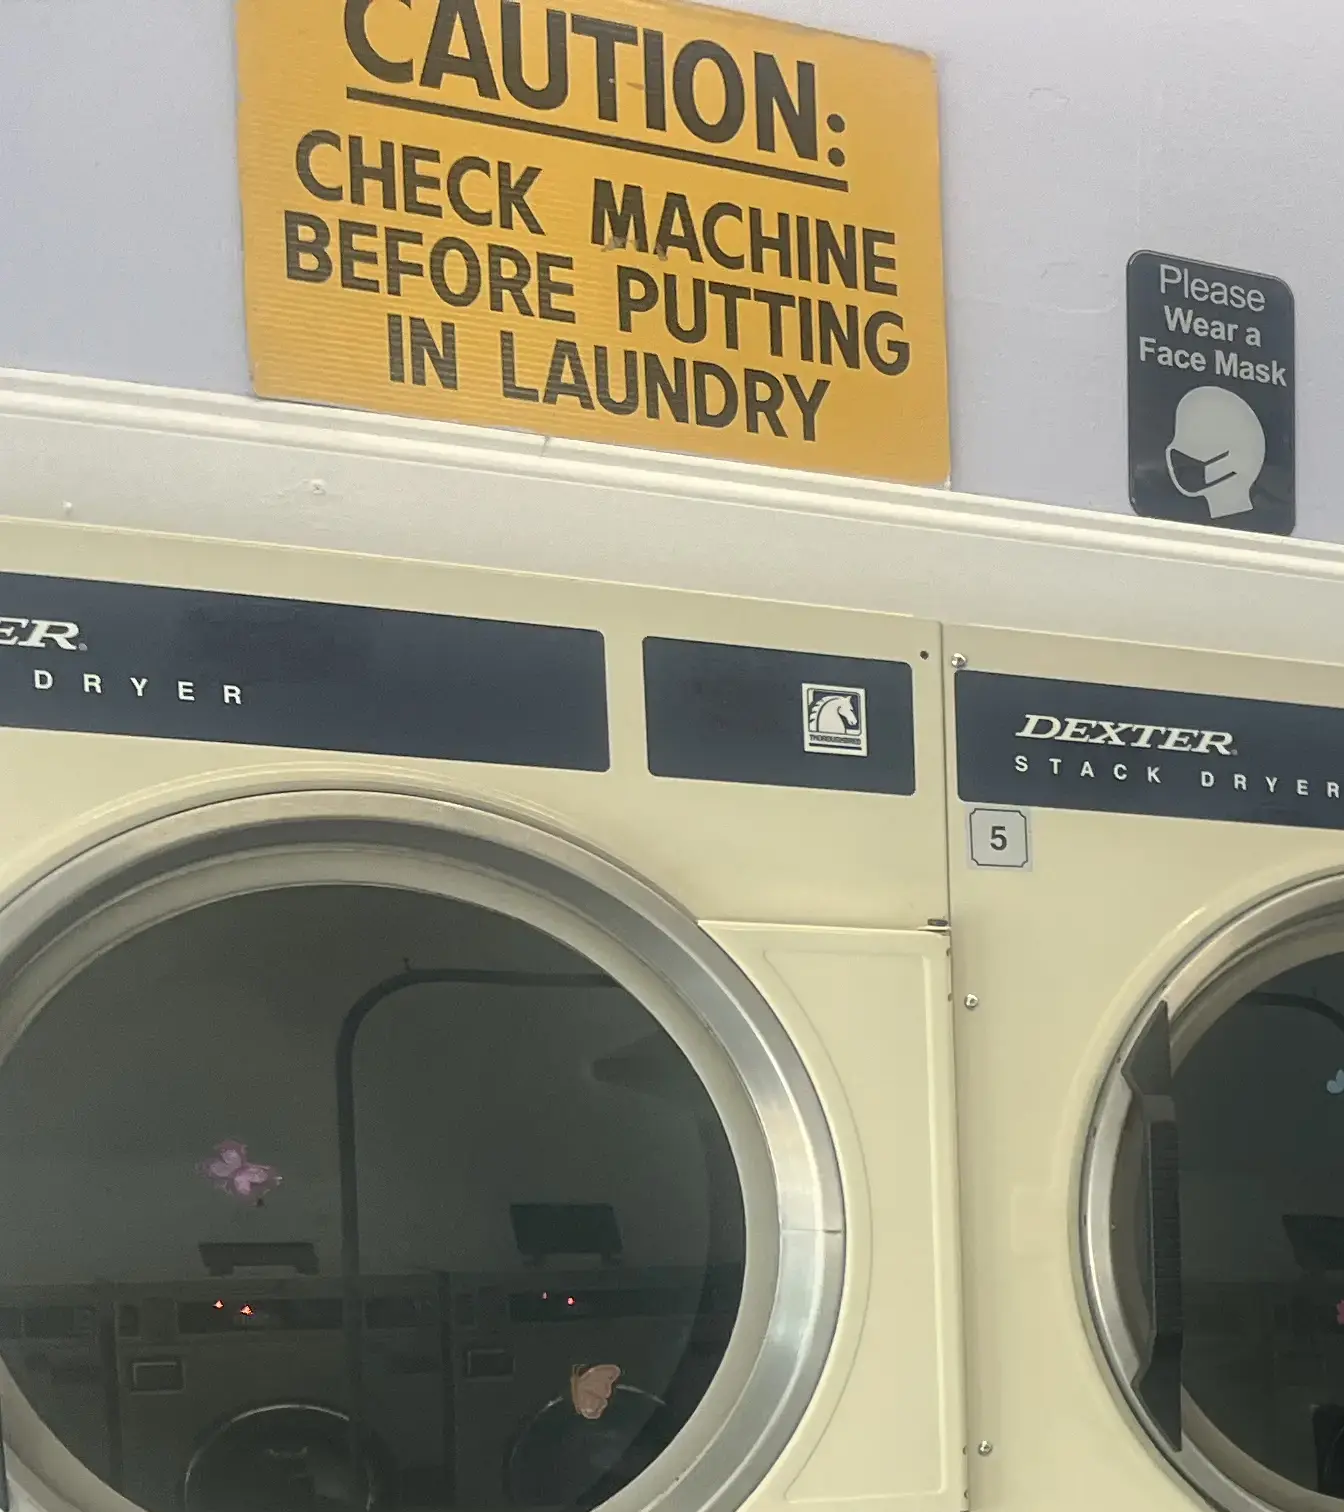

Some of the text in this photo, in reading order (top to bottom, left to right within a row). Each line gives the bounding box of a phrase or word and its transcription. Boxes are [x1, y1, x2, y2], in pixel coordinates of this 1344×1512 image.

[344, 0, 848, 168] CAUTION:
[295, 129, 898, 297] CHECK MACHINE
[284, 210, 911, 377] BEFORE PUTTING
[1159, 264, 1266, 312] Please
[1164, 305, 1261, 347] Wear a
[387, 312, 831, 443] IN LAUNDRY
[1139, 336, 1287, 387] Face Mask
[33, 669, 242, 705] DRYER
[1014, 714, 1234, 756] DEXTER
[1014, 755, 1341, 800] STACK DRYER
[990, 825, 1008, 851] 5
